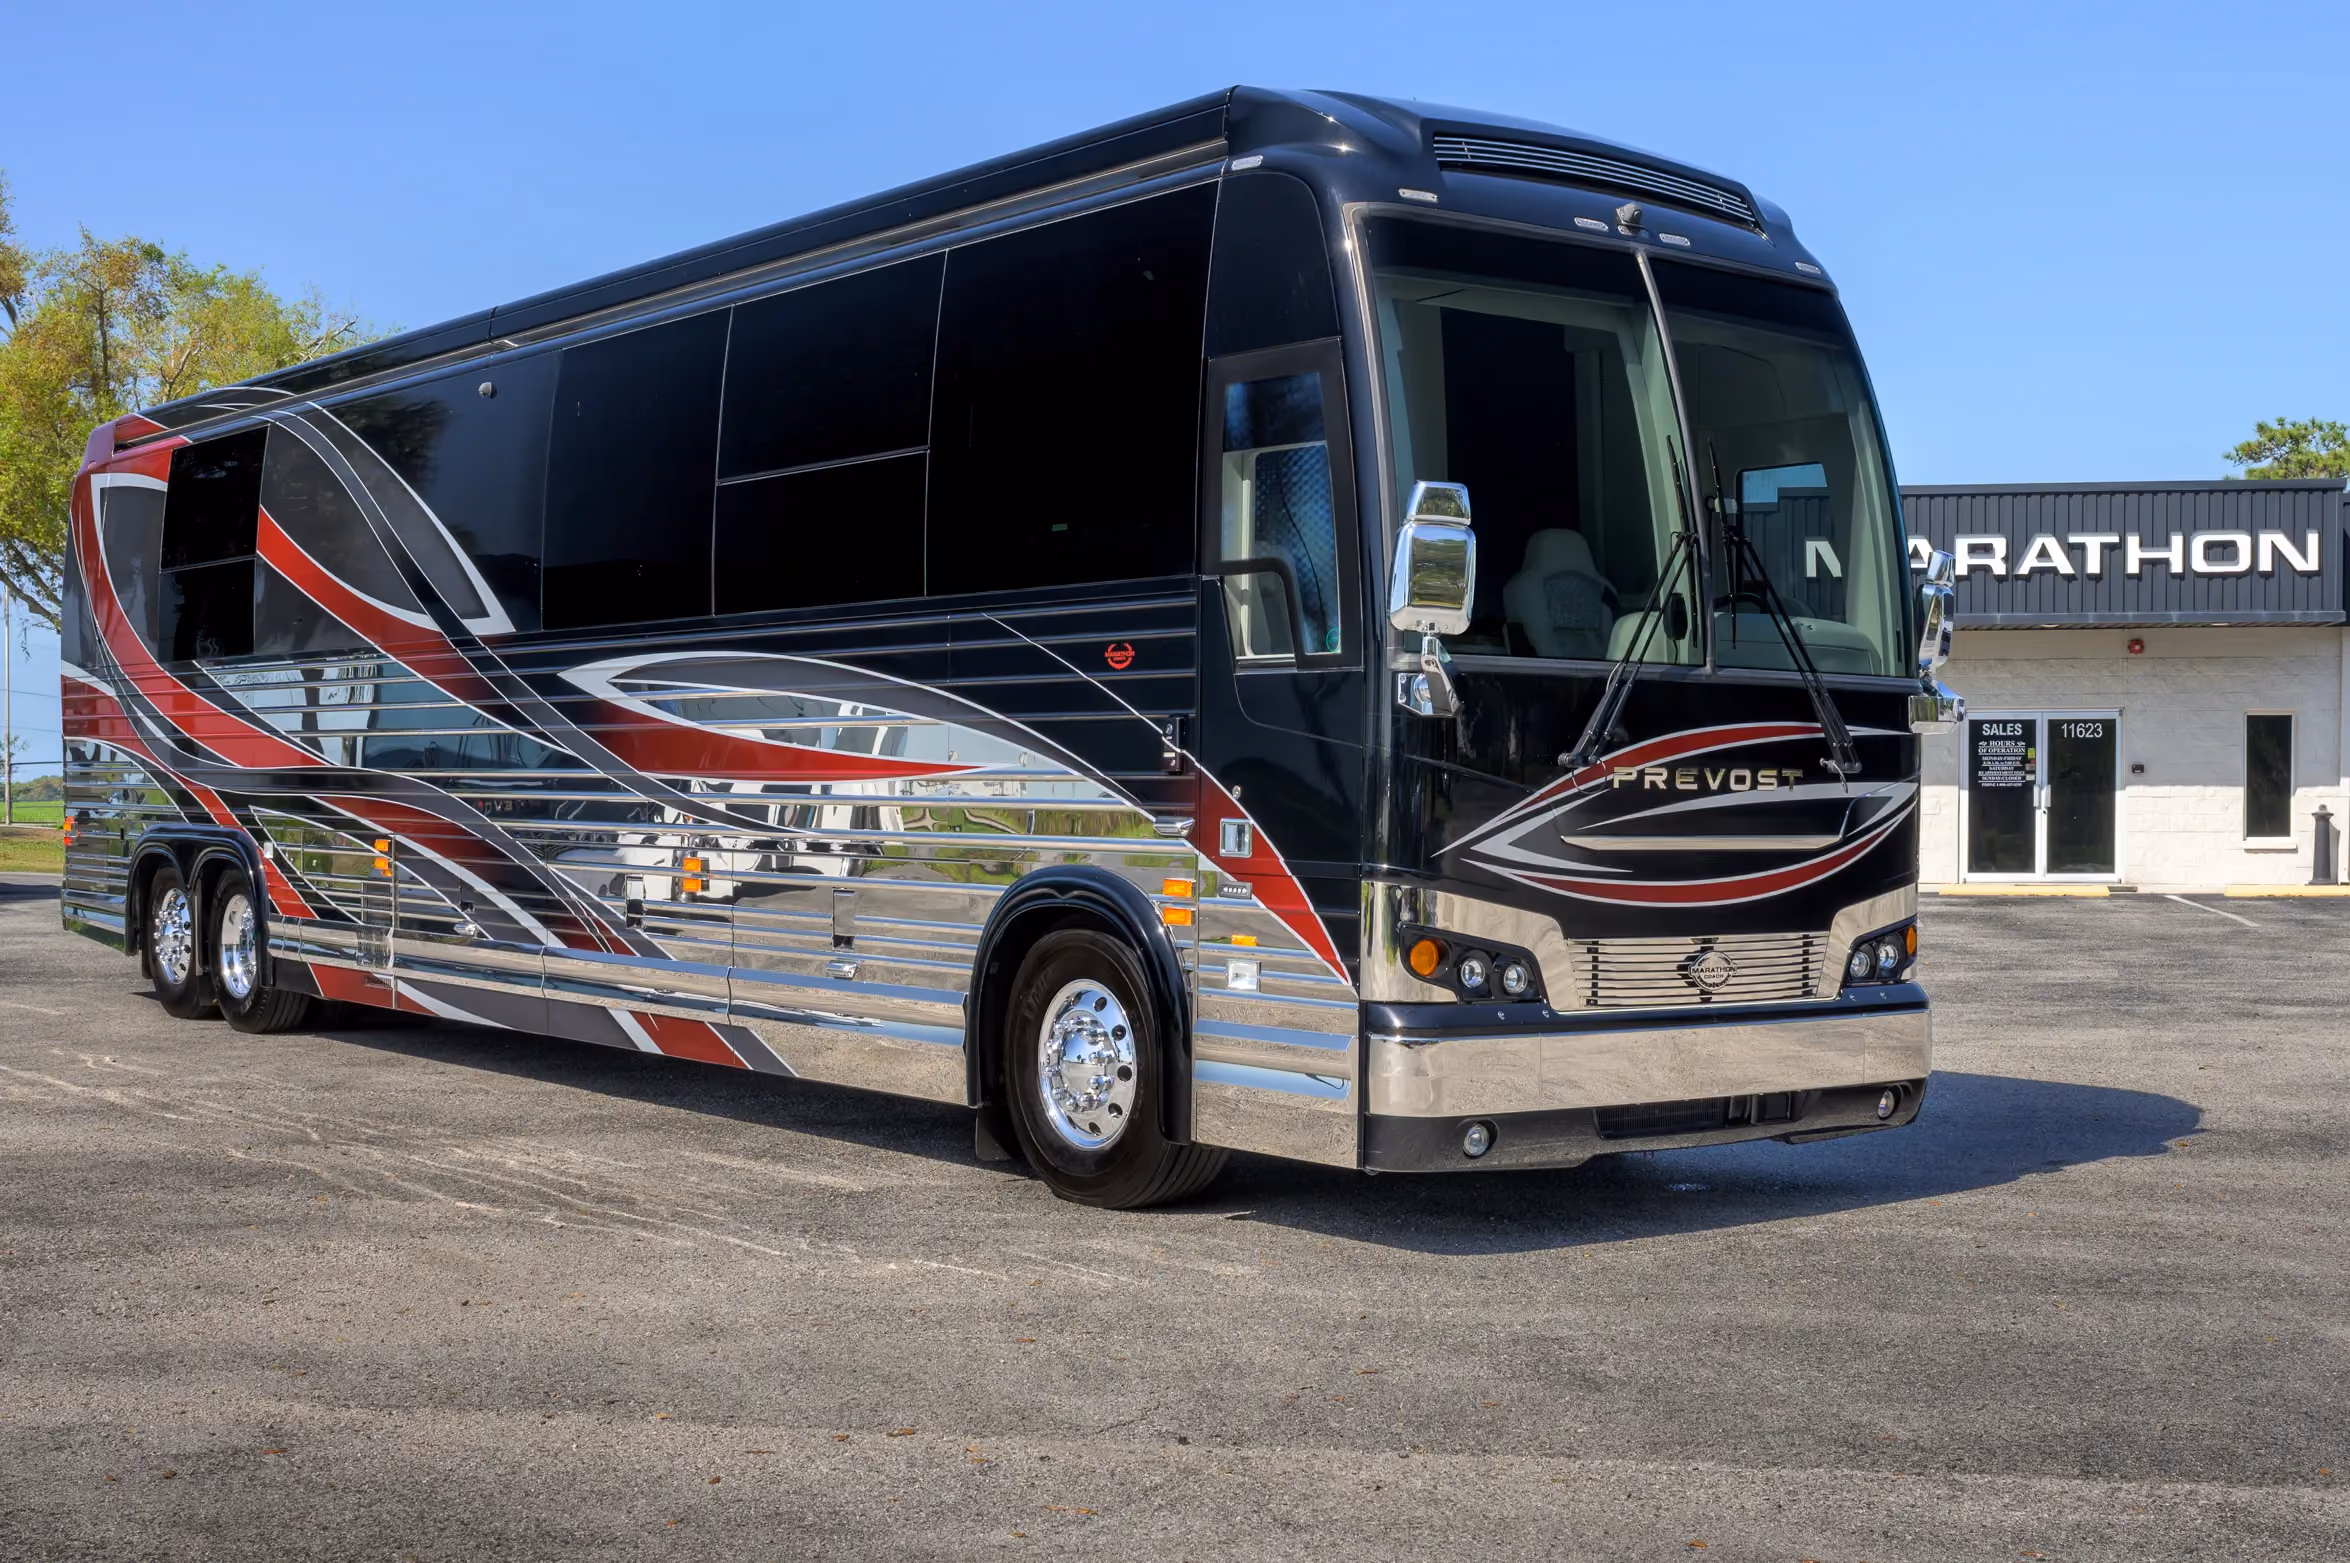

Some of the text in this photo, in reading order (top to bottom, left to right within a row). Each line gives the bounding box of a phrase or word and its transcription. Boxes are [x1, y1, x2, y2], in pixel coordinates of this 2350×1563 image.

[1982, 723, 2022, 736] SALES
[2061, 723, 2102, 738] 11623
[1612, 766, 1803, 792] PREVOST
[1691, 965, 1736, 974] MARATHON
